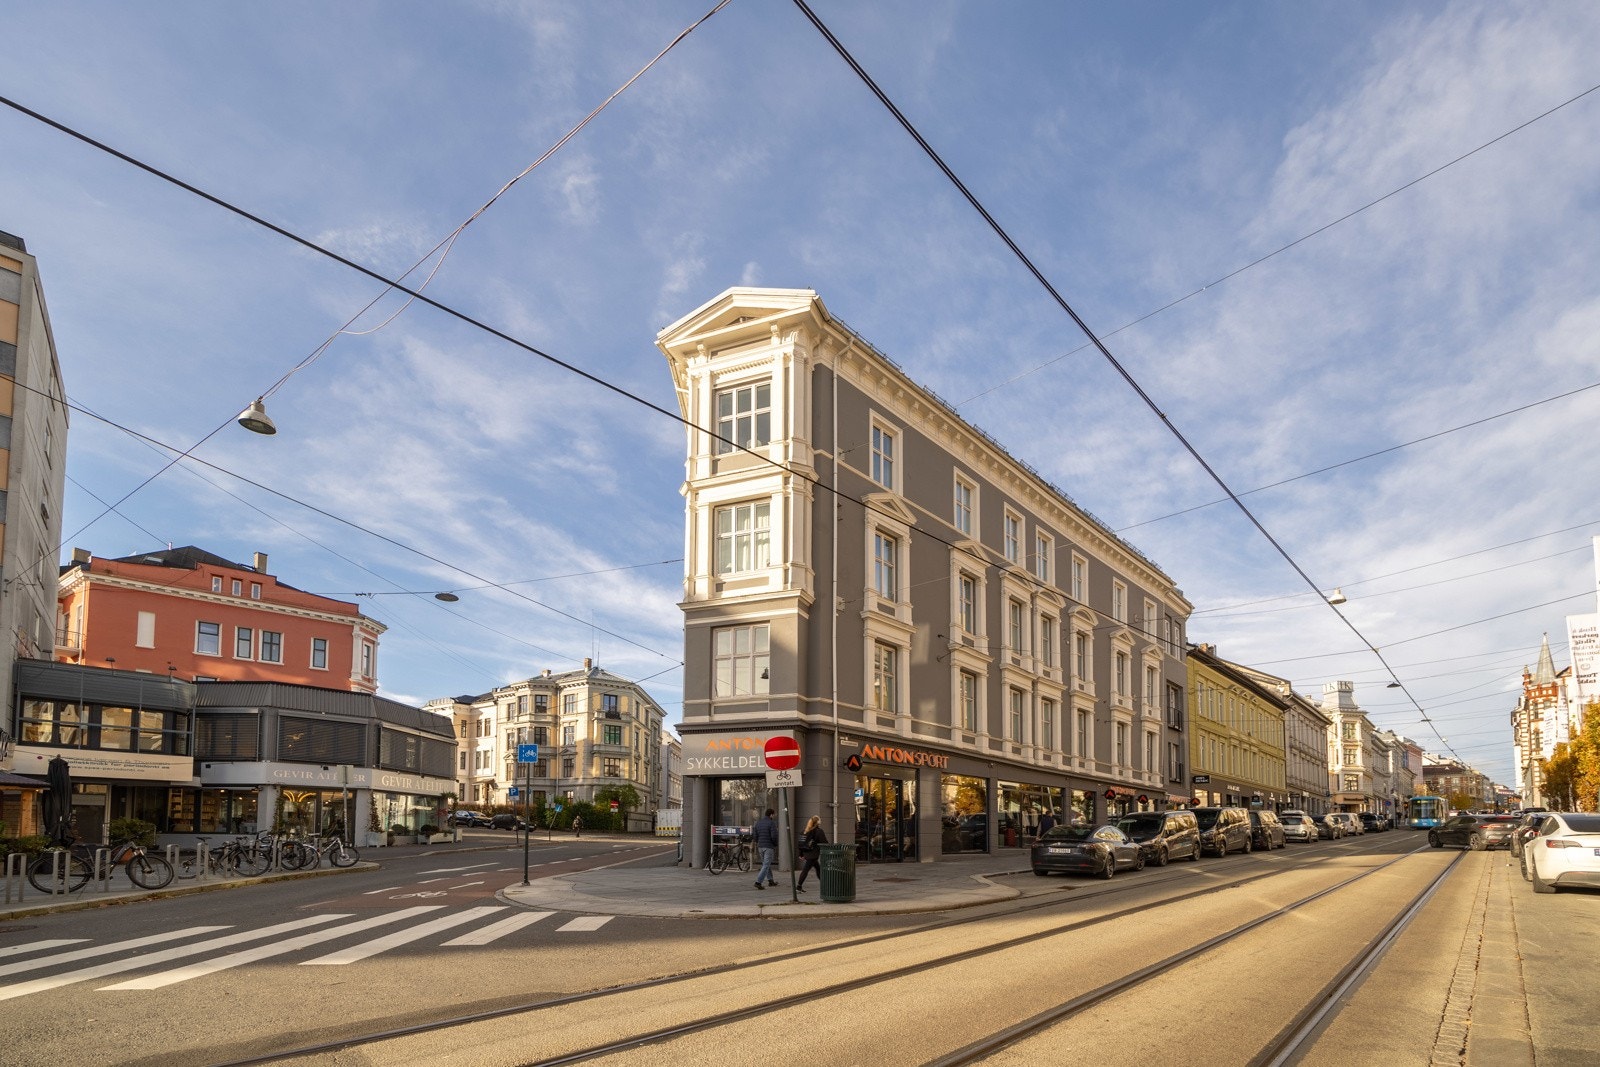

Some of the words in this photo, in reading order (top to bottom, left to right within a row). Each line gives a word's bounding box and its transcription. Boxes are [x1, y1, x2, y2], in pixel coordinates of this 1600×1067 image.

[687, 755, 768, 770] SYKKELDEL
[273, 769, 313, 780] GEVIR
[316, 772, 365, 782] ATEER
[381, 775, 412, 789] GEVIR
